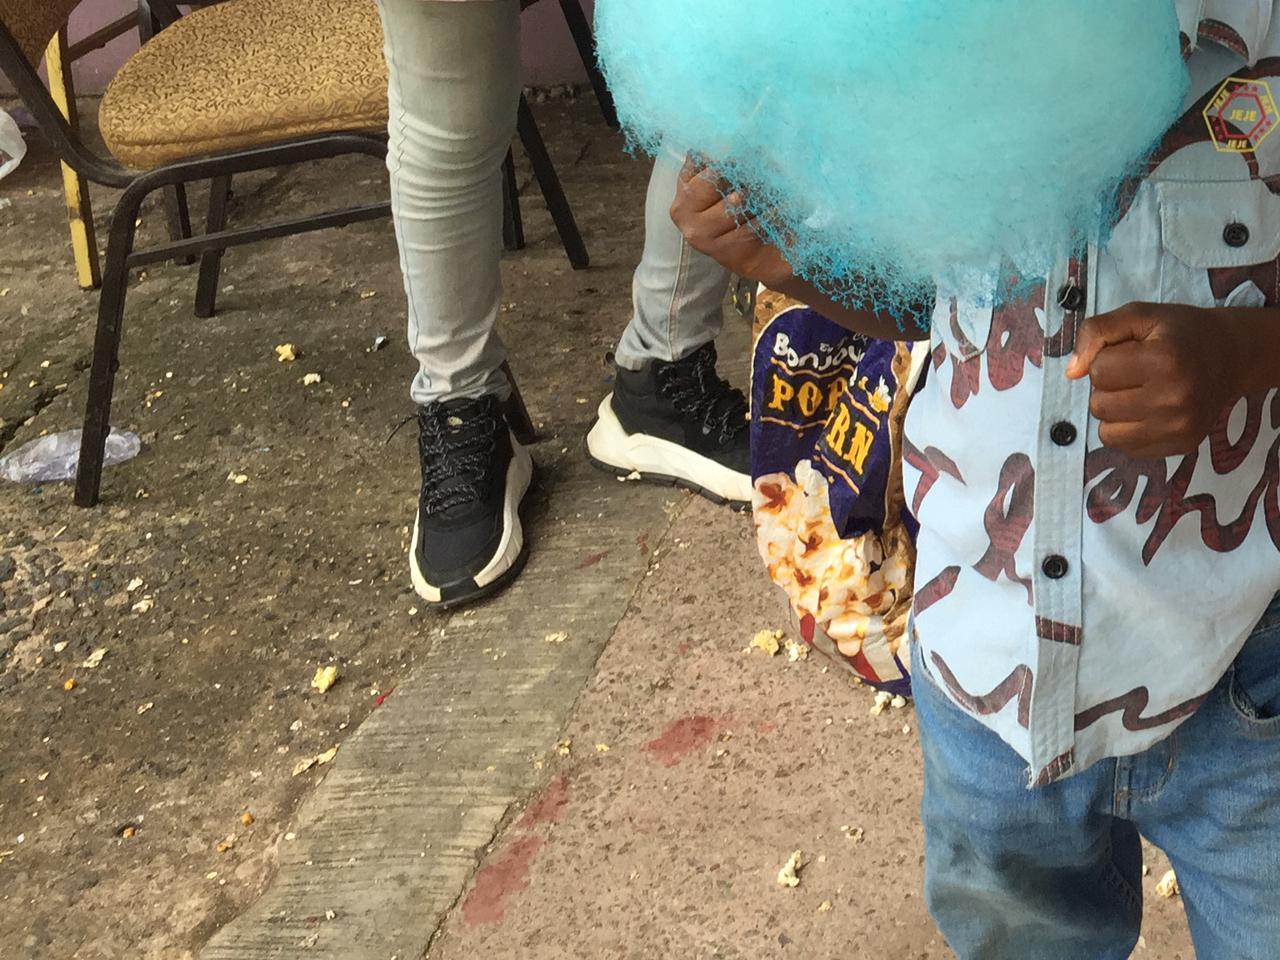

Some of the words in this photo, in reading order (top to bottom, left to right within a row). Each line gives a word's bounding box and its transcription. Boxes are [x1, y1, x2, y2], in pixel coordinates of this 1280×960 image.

[1230, 109, 1257, 121] JEJE
[768, 374, 847, 417] POP
[826, 402, 874, 476] RN
